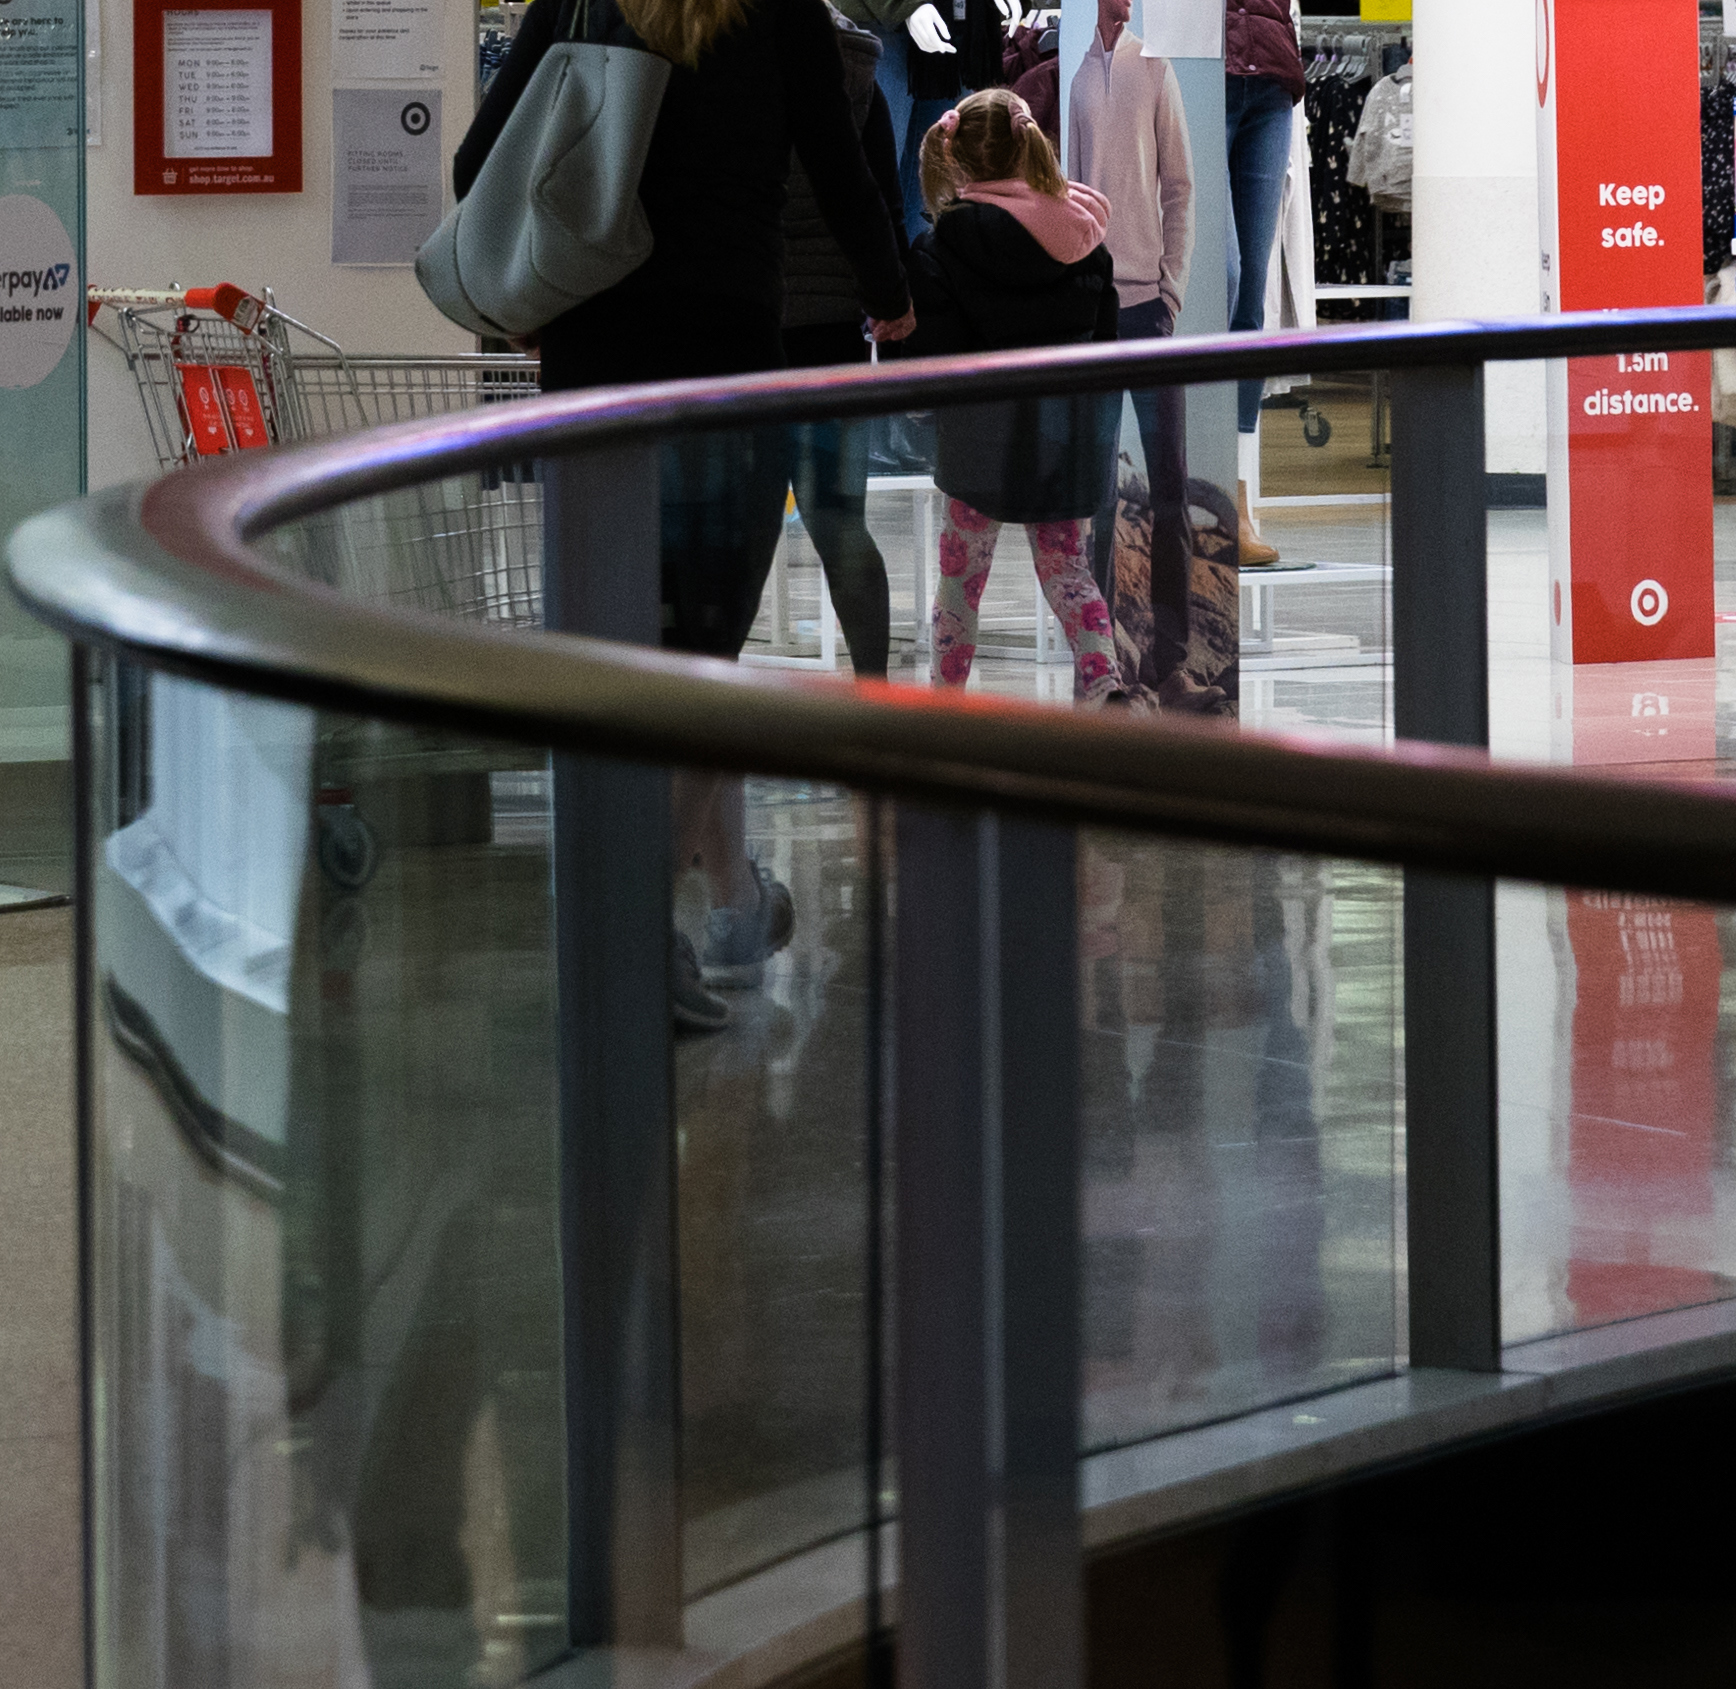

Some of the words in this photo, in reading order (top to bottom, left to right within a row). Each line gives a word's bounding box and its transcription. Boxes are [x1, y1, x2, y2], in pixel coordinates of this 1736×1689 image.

[54, 17, 64, 25] to
[178, 59, 201, 67] MON
[178, 83, 200, 91] WED
[178, 95, 198, 103] THU
[178, 119, 196, 127] SAT
[179, 131, 199, 140] SUN
[1599, 183, 1666, 210] Keep
[1601, 221, 1666, 248] safe.
[35, 307, 65, 322] now
[1616, 352, 1668, 373] 1.5m
[1584, 389, 1700, 416] distance.
